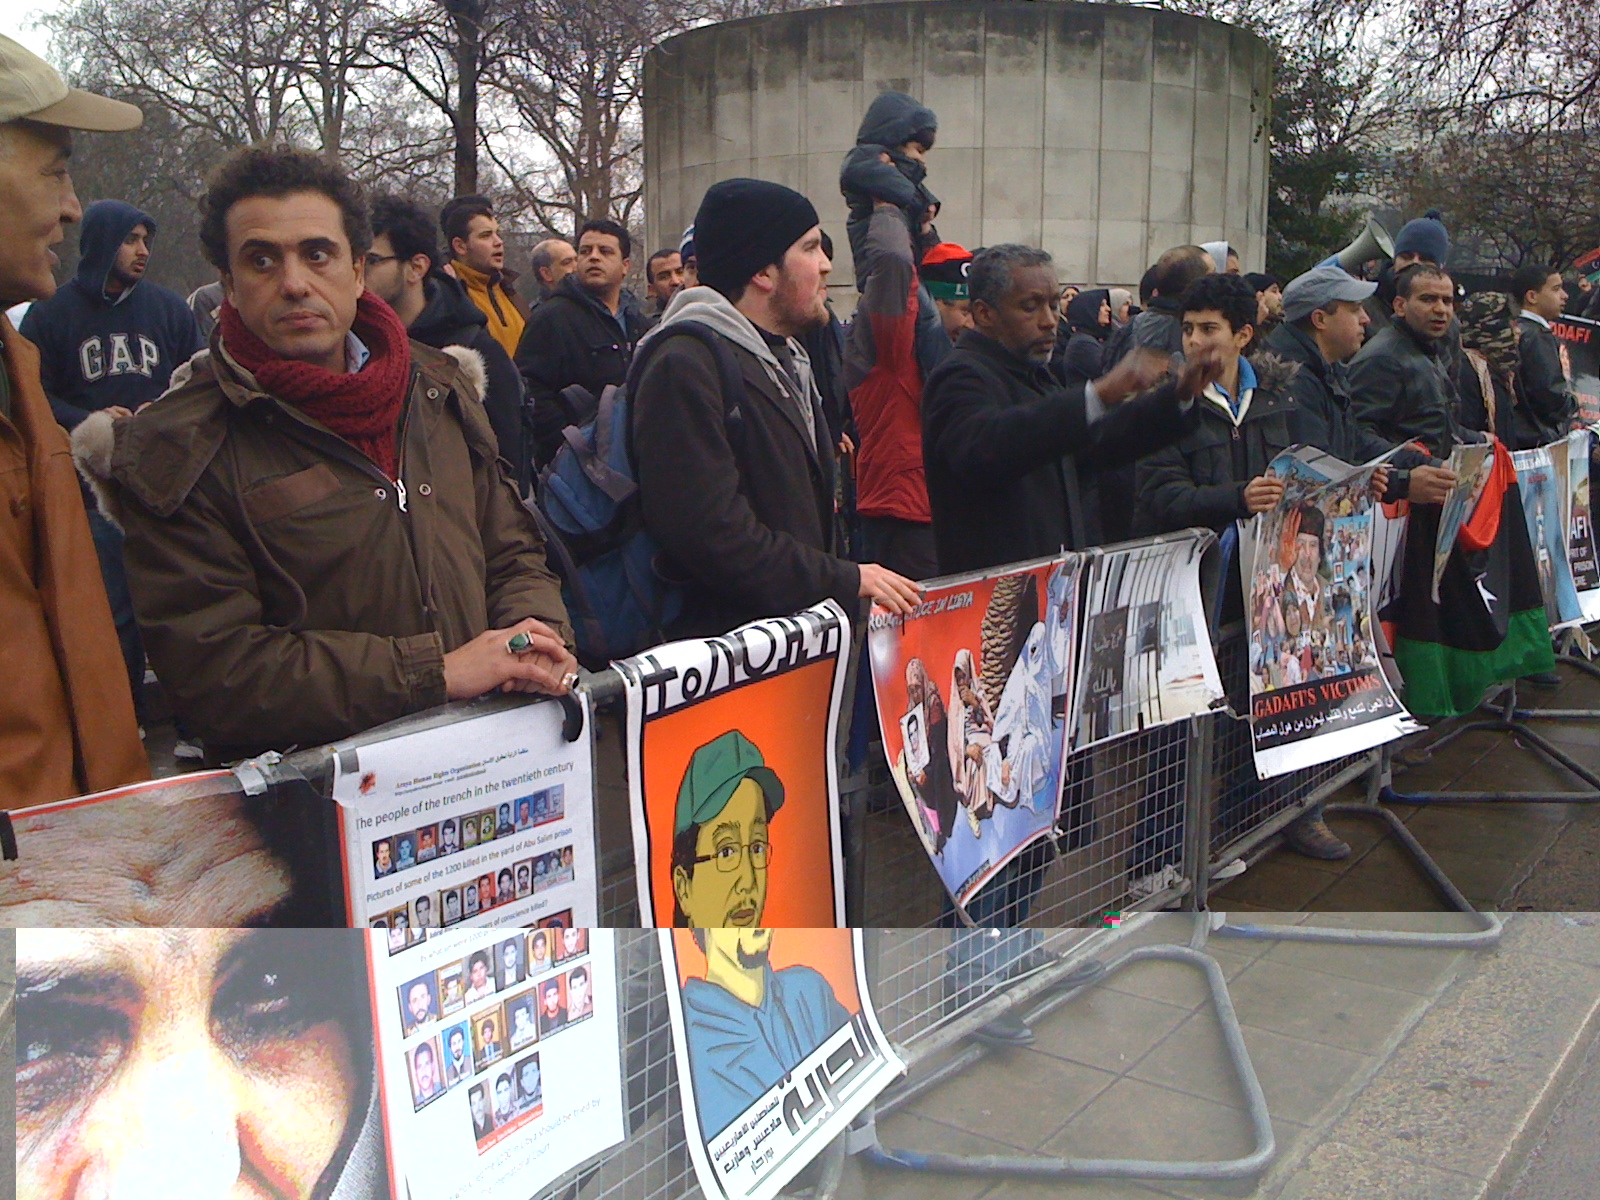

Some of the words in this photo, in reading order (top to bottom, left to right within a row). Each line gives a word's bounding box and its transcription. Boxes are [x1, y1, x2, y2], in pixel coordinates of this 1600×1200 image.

[79, 332, 160, 383] GAP
[946, 591, 974, 612] LIBYA
[1320, 674, 1382, 699] VICTIMS
[355, 813, 373, 830] The
[375, 806, 410, 827] people
[412, 800, 423, 814] of
[424, 797, 441, 812] the
[442, 789, 473, 806] trench
[474, 786, 483, 798] in
[485, 782, 500, 796] the
[501, 772, 542, 791] twentieth
[543, 761, 575, 779] century
[366, 886, 395, 903] Pictures
[395, 881, 403, 893] of
[403, 876, 423, 890] some
[423, 871, 432, 883] of
[431, 867, 444, 880] the
[445, 862, 462, 877] 1200
[462, 855, 481, 871] killed
[481, 853, 488, 864] in
[488, 848, 500, 861] the
[500, 843, 515, 859] yard
[515, 840, 523, 852] of
[523, 836, 536, 849] Abu
[553, 827, 573, 842] prison
[493, 916, 501, 926] of
[501, 909, 530, 922] conscience
[530, 900, 549, 912] killed?
[539, 1117, 562, 1136] should
[563, 1112, 572, 1123] be
[573, 1102, 591, 1117] tried
[591, 1097, 601, 1109] by
